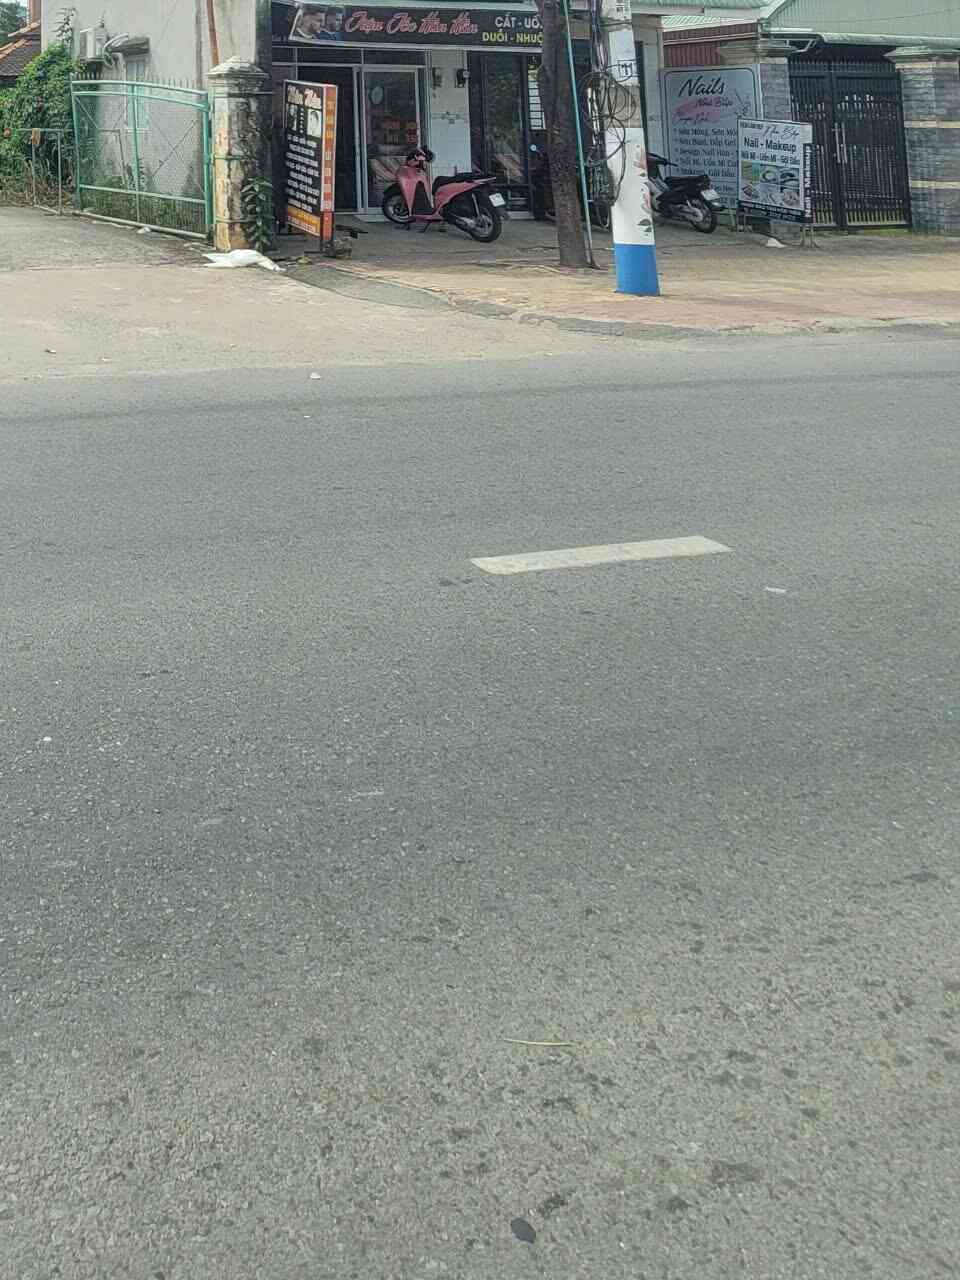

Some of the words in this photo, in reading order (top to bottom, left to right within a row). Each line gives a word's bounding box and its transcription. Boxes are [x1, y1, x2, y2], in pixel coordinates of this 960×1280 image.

[516, 30, 544, 45] NHUỘ
[678, 75, 726, 97] Nails
[743, 136, 759, 149] Nail
[765, 139, 797, 155] Makeup
